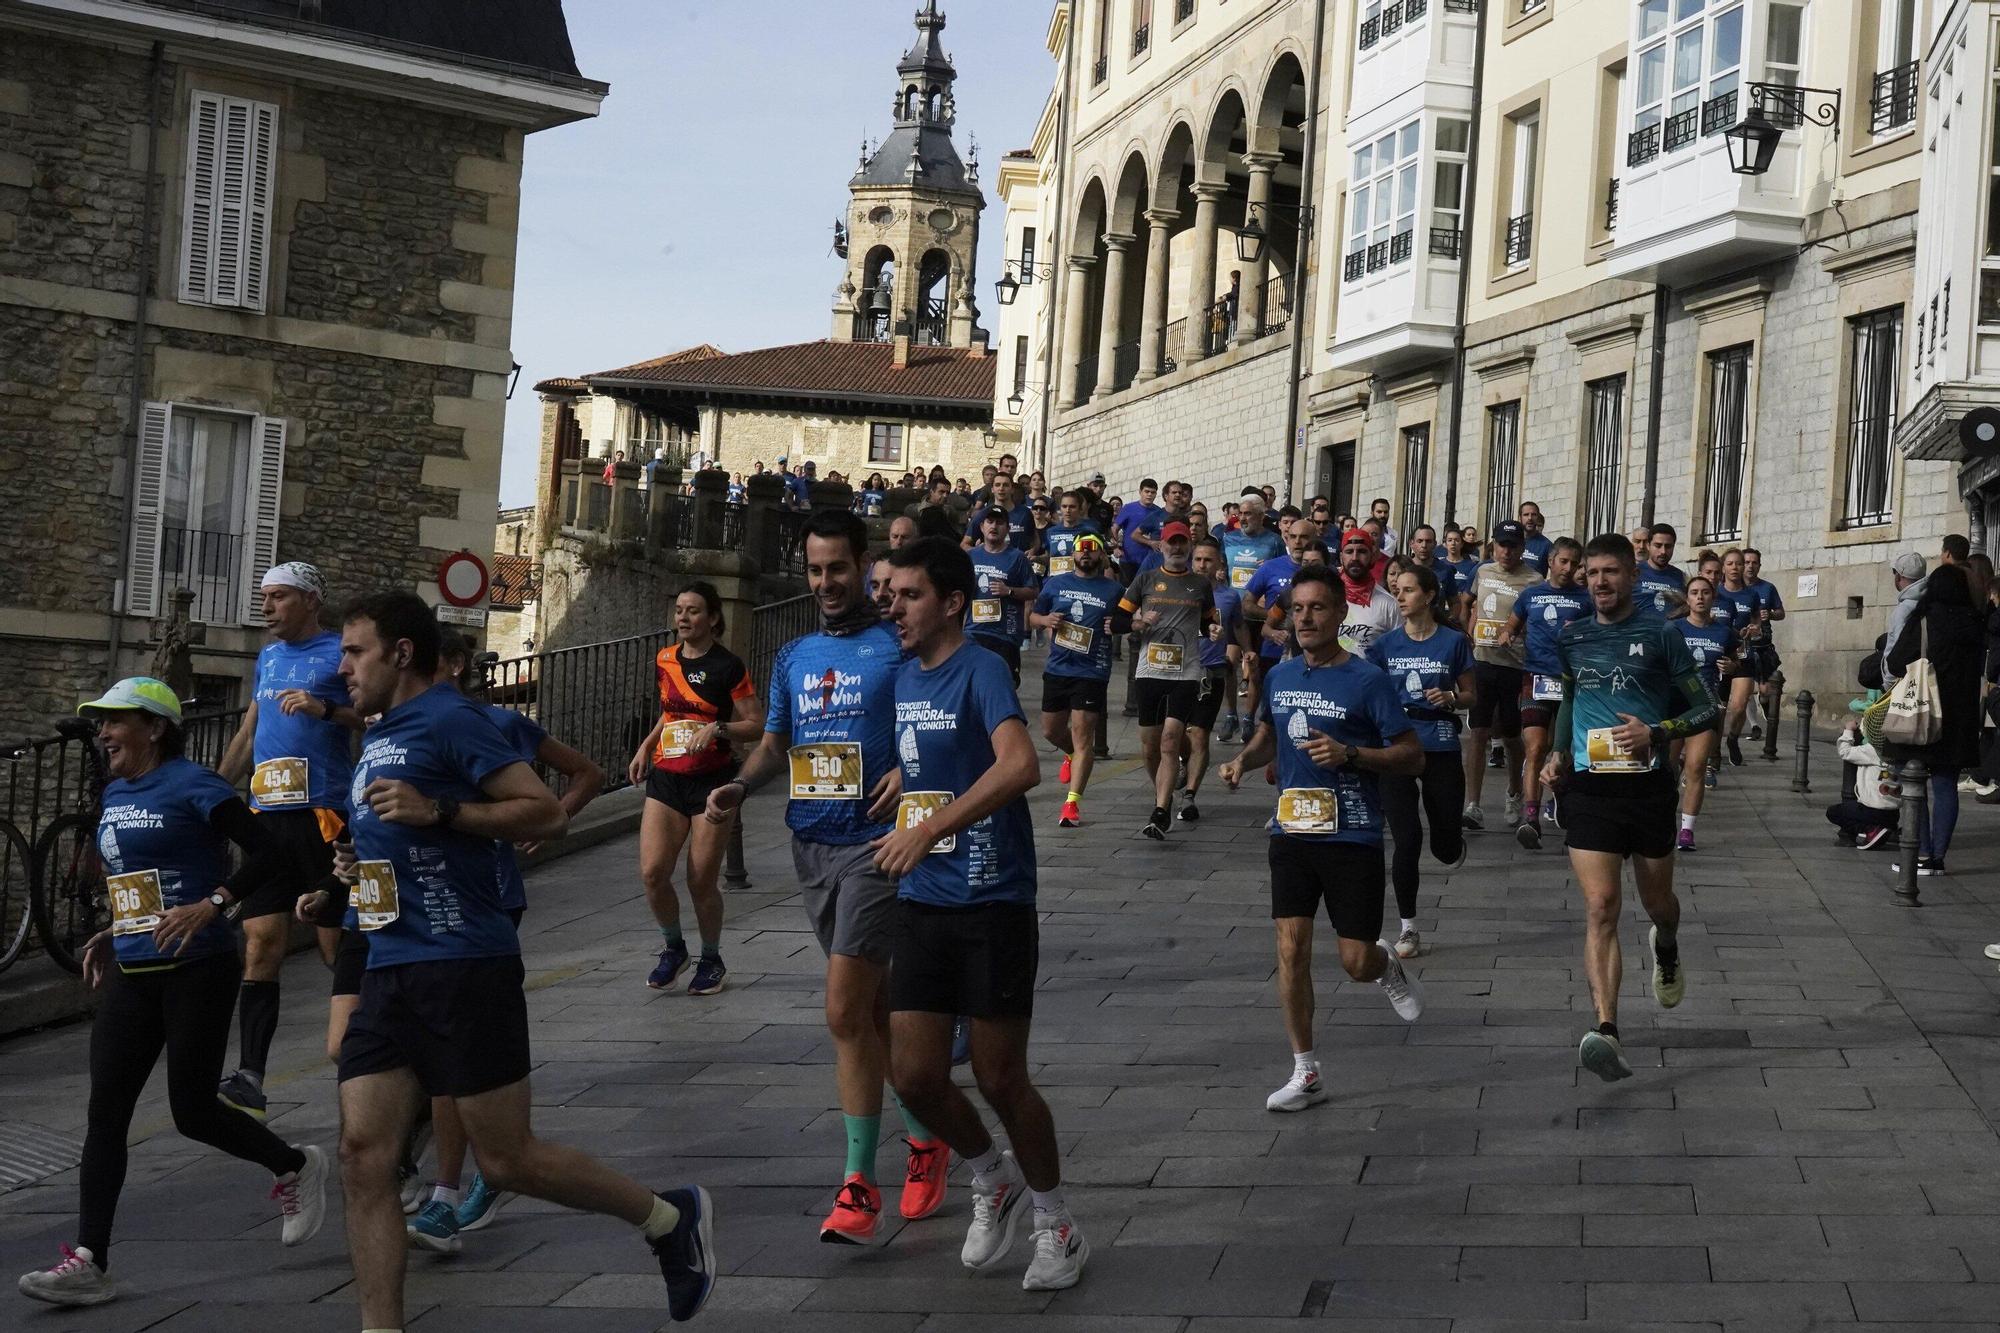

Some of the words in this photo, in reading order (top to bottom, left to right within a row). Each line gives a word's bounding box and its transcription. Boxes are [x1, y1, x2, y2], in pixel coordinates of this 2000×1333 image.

[1544, 682, 1561, 692] 753
[1280, 690, 1322, 700] CONQUISTA
[1280, 698, 1336, 710] ALMENDRA
[1308, 708, 1346, 720] KONKISTA
[916, 720, 956, 730] KONKISTA
[810, 756, 842, 778] 150
[264, 770, 292, 788] 454
[1293, 800, 1321, 817] 354
[117, 820, 164, 829] KONKISTA
[115, 888, 141, 912] 136
